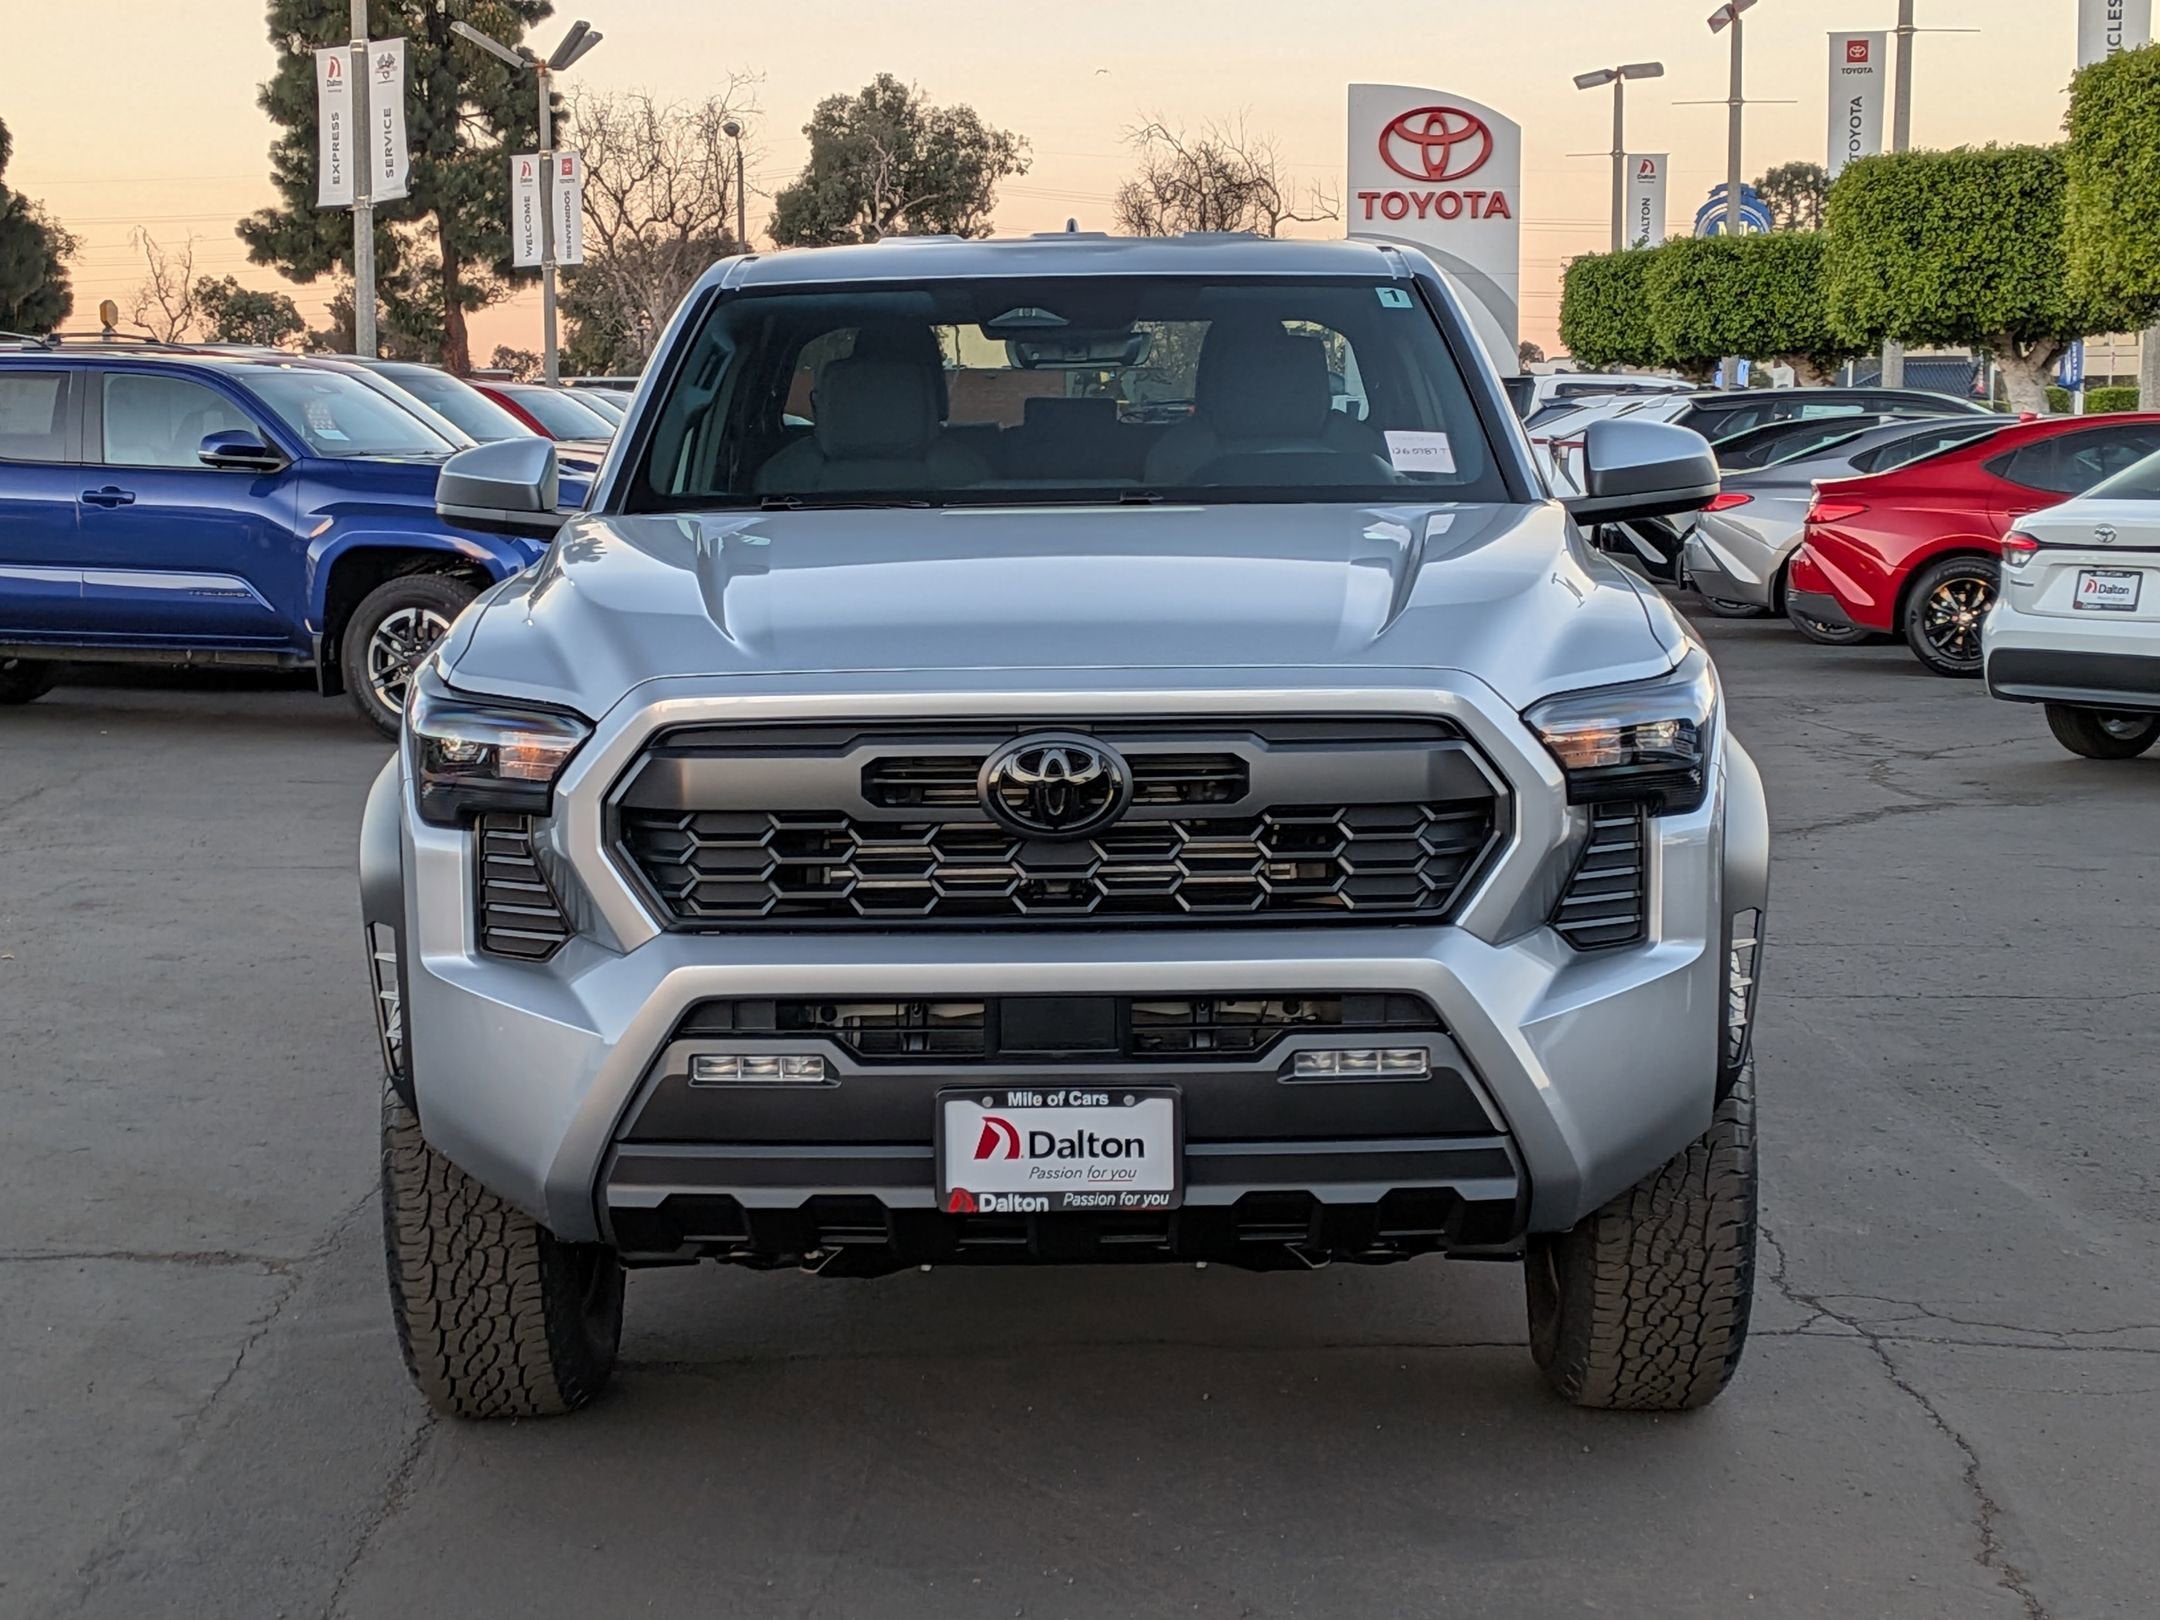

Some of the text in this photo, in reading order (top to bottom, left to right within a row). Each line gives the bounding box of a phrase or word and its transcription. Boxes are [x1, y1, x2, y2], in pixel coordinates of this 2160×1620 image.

[2107, 0, 2124, 58] ICLES
[1841, 67, 1873, 75] TOYOTA
[383, 108, 394, 178] SERVICE
[1849, 95, 1863, 161] TOYOTA
[331, 112, 341, 185] EXPRESS
[1358, 191, 1511, 220] TOYOTA
[524, 195, 533, 257] WELCOME
[564, 190, 572, 259] BIENVENIDOS
[2098, 583, 2130, 595] Dalton
[1008, 1091, 1109, 1107] Mile of Cars
[1029, 1129, 1145, 1159] Dalton
[1028, 1165, 1137, 1181] Passion for you
[979, 1191, 1169, 1213] Dalton Passion for you
